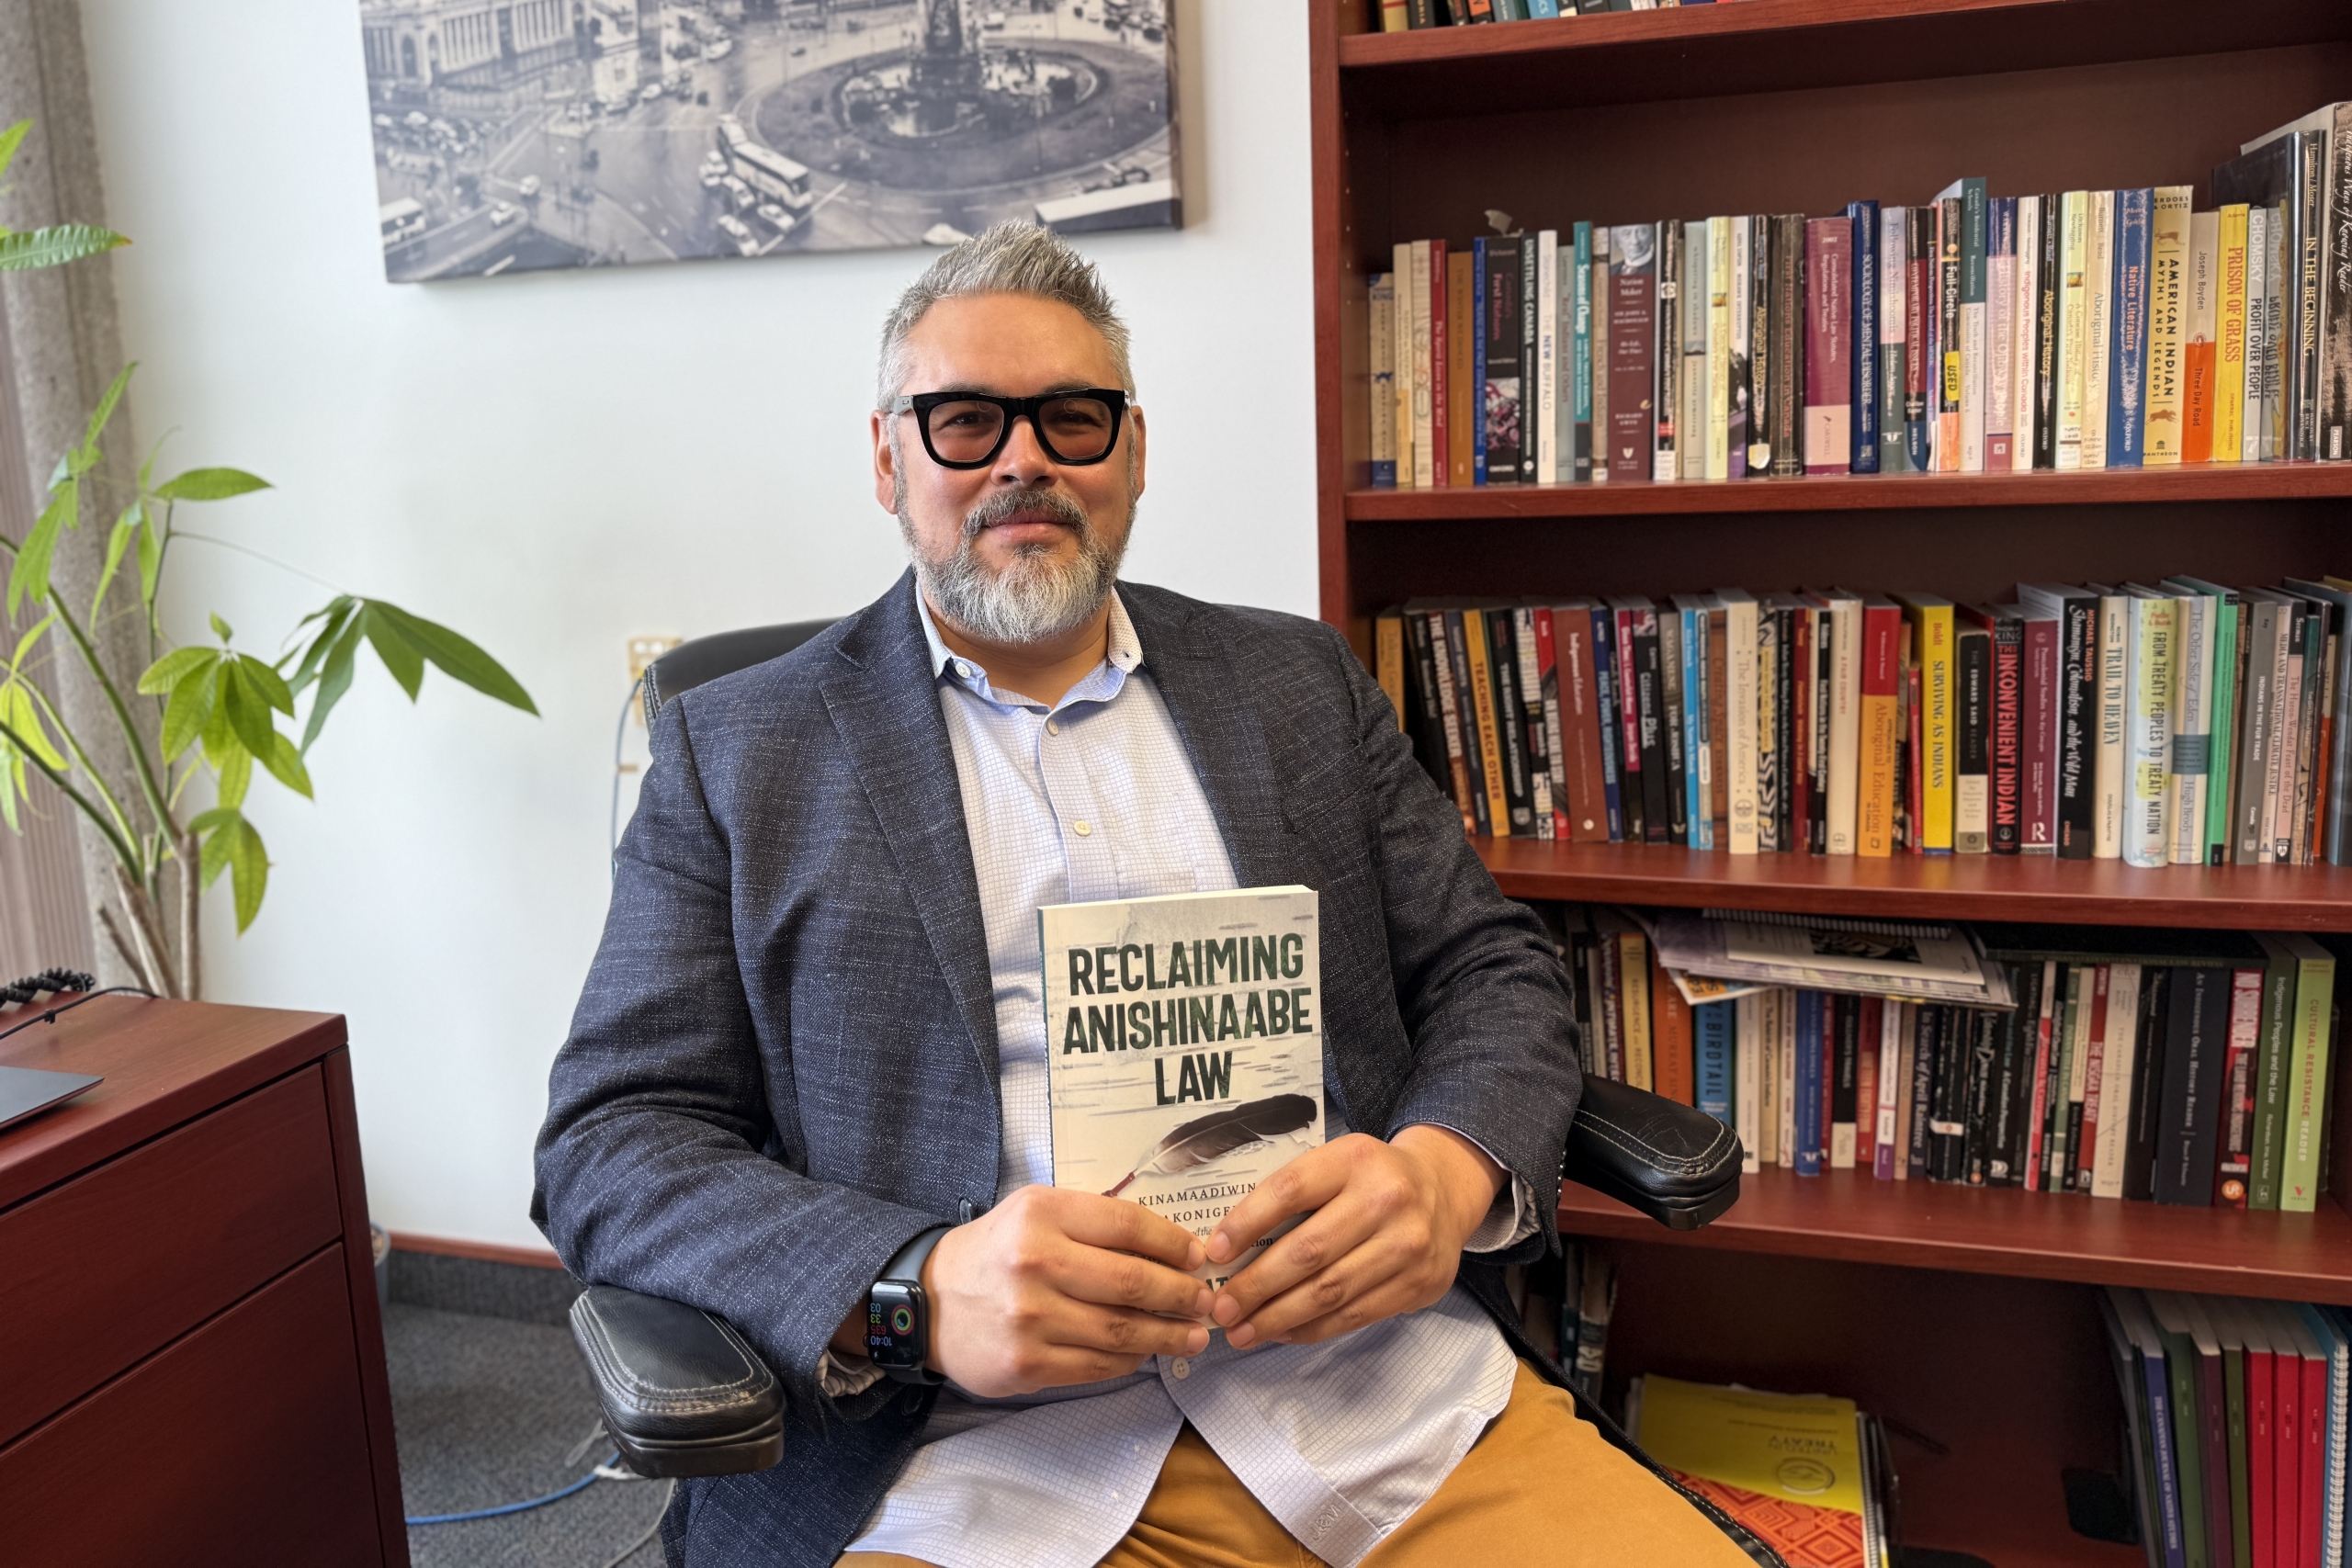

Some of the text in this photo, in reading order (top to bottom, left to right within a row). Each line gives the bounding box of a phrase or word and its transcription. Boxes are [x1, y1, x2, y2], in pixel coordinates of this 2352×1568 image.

[1523, 238, 1534, 299] UNSETTLING
[1829, 254, 1838, 296] Consolidated
[2250, 215, 2263, 282] CHOMSKY
[1821, 254, 1829, 333] Regulations and Treaties
[1829, 299, 1838, 319] Native
[1861, 254, 1872, 305] SOCIOLOGY
[1946, 265, 1957, 319] Full Circle
[2125, 266, 2138, 351] Native Literature
[2195, 251, 2207, 310] Joseph Boyden
[2223, 247, 2244, 363] PRISON OF GRASS
[2303, 237, 2318, 356] IN THE BEGINNING
[1523, 302, 1534, 344] CANADA
[1829, 321, 1838, 334] Law
[1861, 308, 1872, 321] OF
[1861, 323, 1872, 358] MENTAL
[2020, 271, 2032, 412] Indigenous Peoples within Canada
[2041, 290, 2053, 376] Aboriginal History
[2091, 291, 2104, 389] Aboriginal History
[2153, 259, 2165, 397] MYTHS AND LEGENDS
[2163, 259, 2179, 397] AMERICAN INDIAN
[1947, 365, 1958, 391] USED
[2248, 298, 2262, 400] PROFIT OVER PEOPLE
[1861, 361, 1872, 404] DISORDER
[2192, 367, 2203, 426] Three Day Road
[2332, 428, 2340, 457] PEARSON
[1429, 614, 1447, 638] THE
[1933, 623, 1943, 646] Boldt
[2084, 609, 2095, 682] MICHAEL TAUSSIG
[2190, 632, 2202, 660] Other
[2191, 610, 2202, 629] The
[2295, 617, 2304, 642] Seeman
[1432, 639, 1456, 712] KNOWLEDGE
[1970, 669, 1978, 703] EDWARD
[2064, 604, 2086, 798] Shamanism, Colonialism, and the Wild Man
[2102, 647, 2122, 746] TRAIL TO HEAVEN
[2190, 662, 2201, 682] Side
[2256, 676, 2266, 704] INDIANS
[1442, 714, 1463, 758] SEEKER
[1475, 661, 1501, 800] TEACHING EACH OTHER
[1736, 660, 1750, 784] The Invasion of America
[1932, 660, 1944, 788] SURVIVING AS INDIANS
[1970, 705, 1978, 726] SAID
[1996, 654, 2018, 825] INCONVENIENT INDIAN
[2146, 632, 2166, 835] FROM TREATY PEOPLES TO TREATY NATION
[2188, 698, 2198, 722] Eden
[2254, 727, 2263, 739] FUR
[2255, 713, 2264, 726] THE
[2267, 633, 2289, 796] MEDIA AND TRANSNATIONAL CLIMATE JUSTICE
[1871, 703, 1889, 833] Aboriginal Education
[2253, 740, 2262, 761] TRADE
[2281, 676, 2300, 814] The Huron-Wendat Feast of the Dead
[2179, 807, 2193, 833] Brody
[2180, 781, 2194, 806] Hugh
[1068, 932, 1304, 996] RECLAIMING
[1063, 987, 1313, 1055] ANISHINAABE
[2230, 973, 2262, 1048] NO SURRENDER
[2267, 976, 2286, 1103] Indigenous Peoples and the Law
[1154, 1051, 1233, 1106] LAW
[1706, 1022, 1723, 1096] BIRDTAIL
[1913, 1012, 1933, 1148] In Search of April Raintree
[2298, 999, 2319, 1161] CULTURAL RESISTANCE READER
[1138, 1182, 1257, 1207] KINAMAADIWIN
[870, 1314, 882, 1324] 33
[870, 1336, 892, 1346] 10:40
